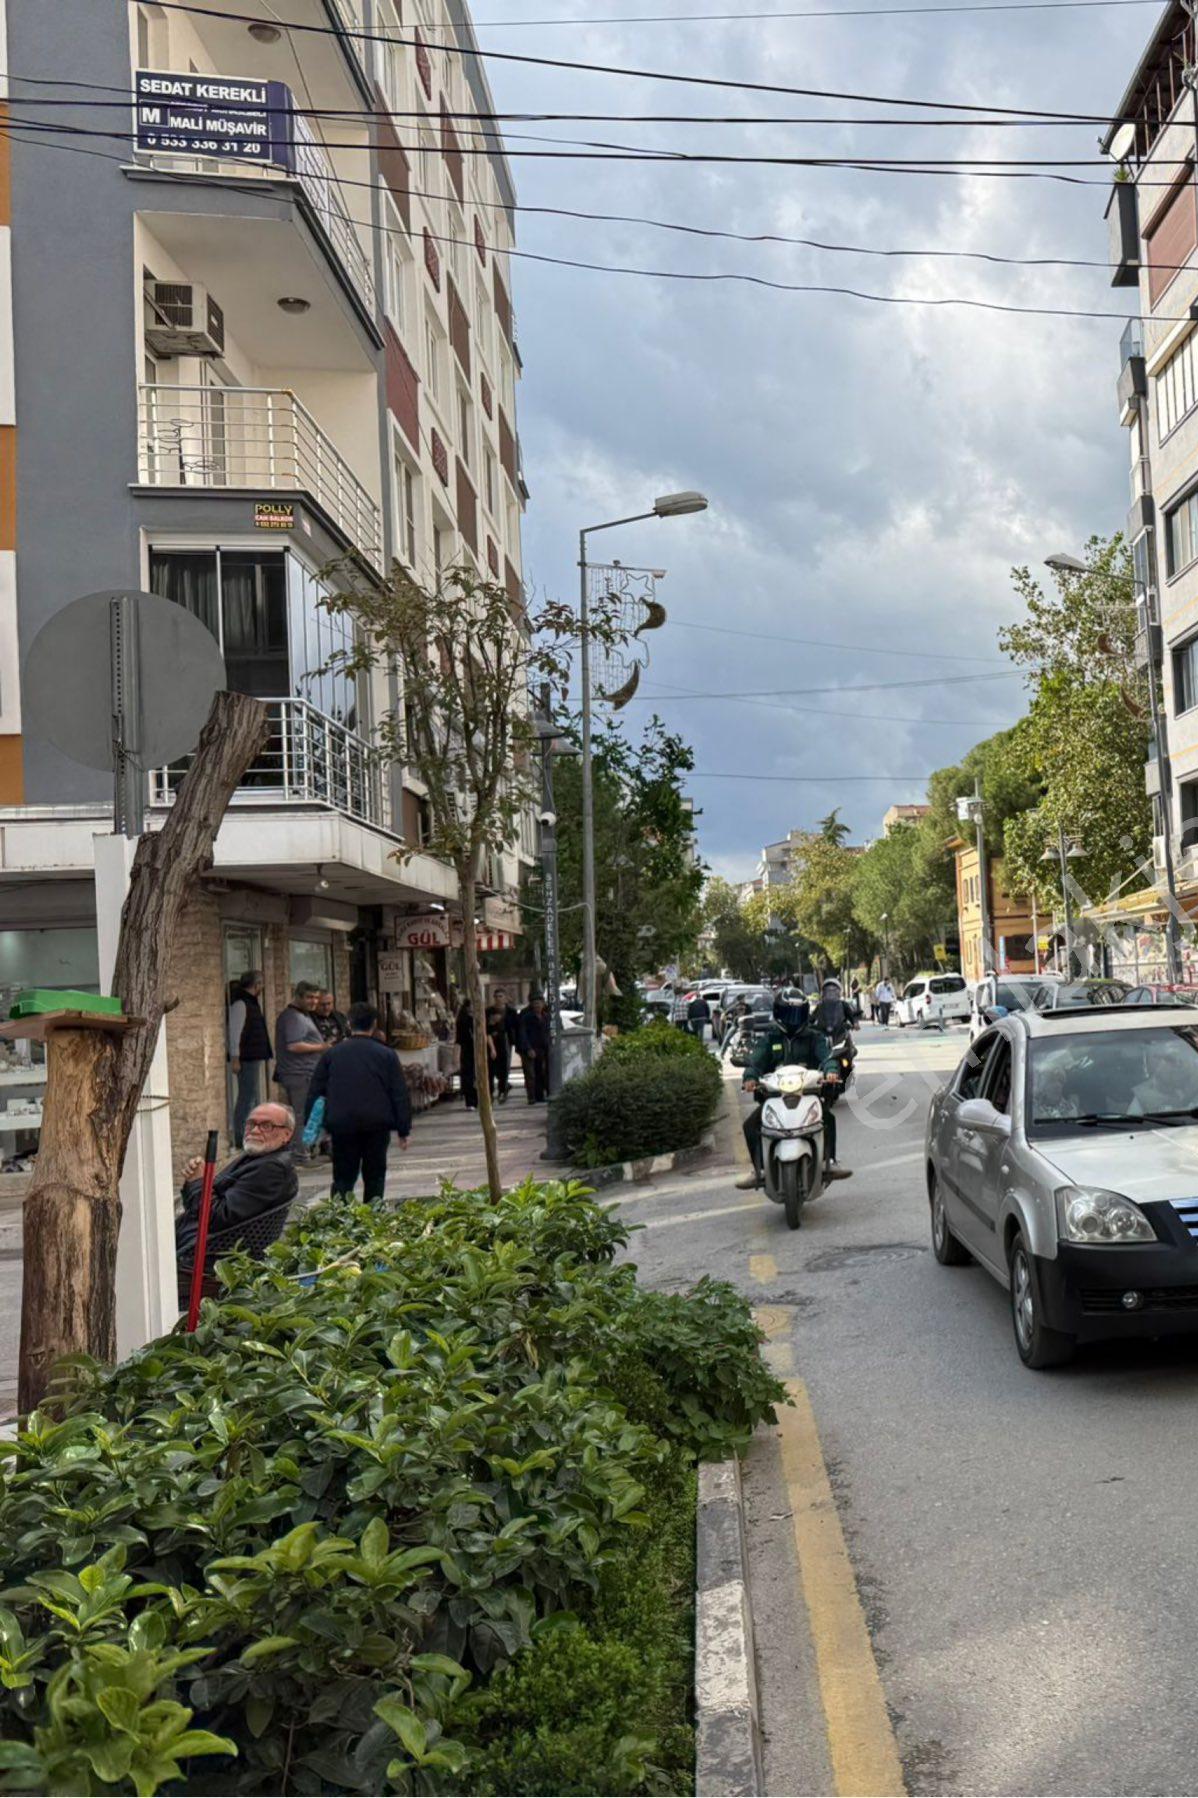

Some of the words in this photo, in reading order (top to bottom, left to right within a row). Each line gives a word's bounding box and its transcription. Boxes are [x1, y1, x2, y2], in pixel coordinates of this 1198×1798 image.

[140, 79, 192, 96] SEDAT
[196, 84, 266, 104] KEREKLİ
[170, 116, 203, 130] MALİ
[206, 119, 267, 136] MÜŞAVİR
[243, 142, 261, 153] 20
[255, 504, 293, 516] POLLY
[408, 929, 440, 946] GÜL
